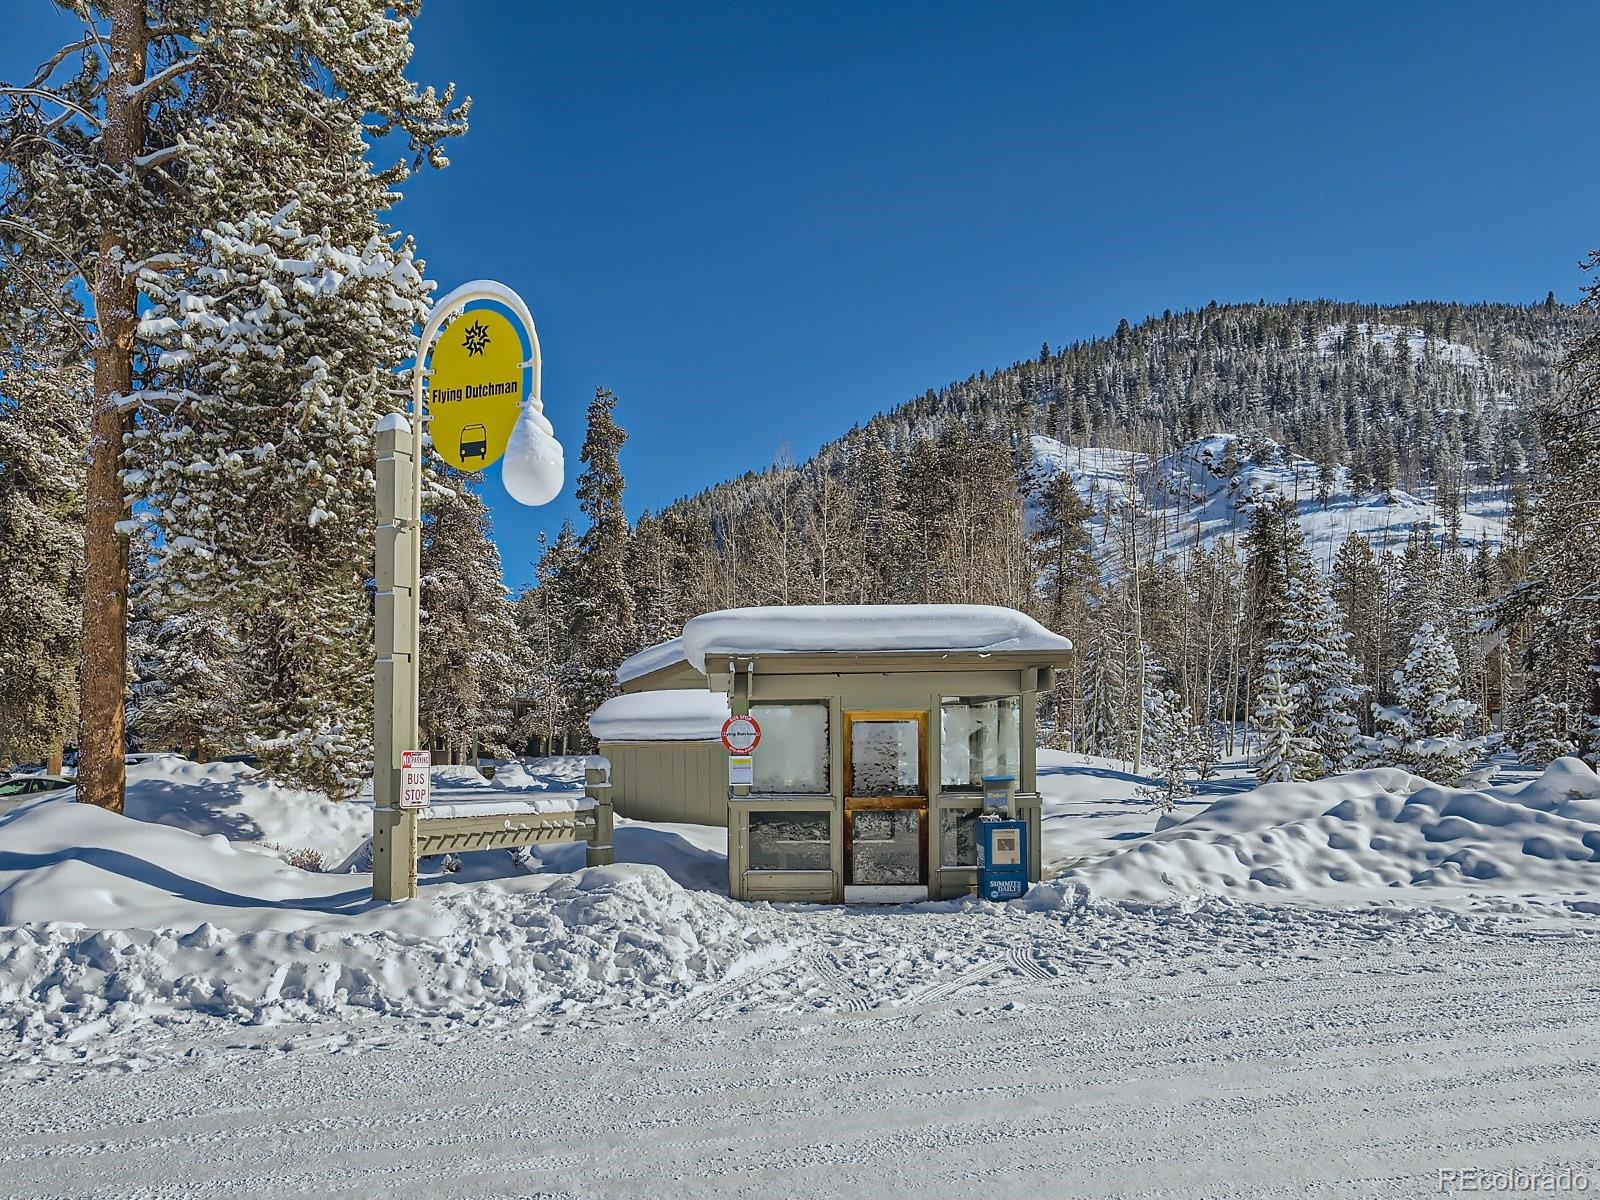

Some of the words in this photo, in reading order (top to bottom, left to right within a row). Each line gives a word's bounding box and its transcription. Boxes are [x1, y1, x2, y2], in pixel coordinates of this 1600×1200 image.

[433, 388, 462, 404] Flying
[466, 381, 518, 399] Dutchman
[403, 755, 411, 765] NO
[407, 773, 425, 785] BUS
[405, 789, 426, 801] STOP
[989, 880, 1017, 888] SUMMIT
